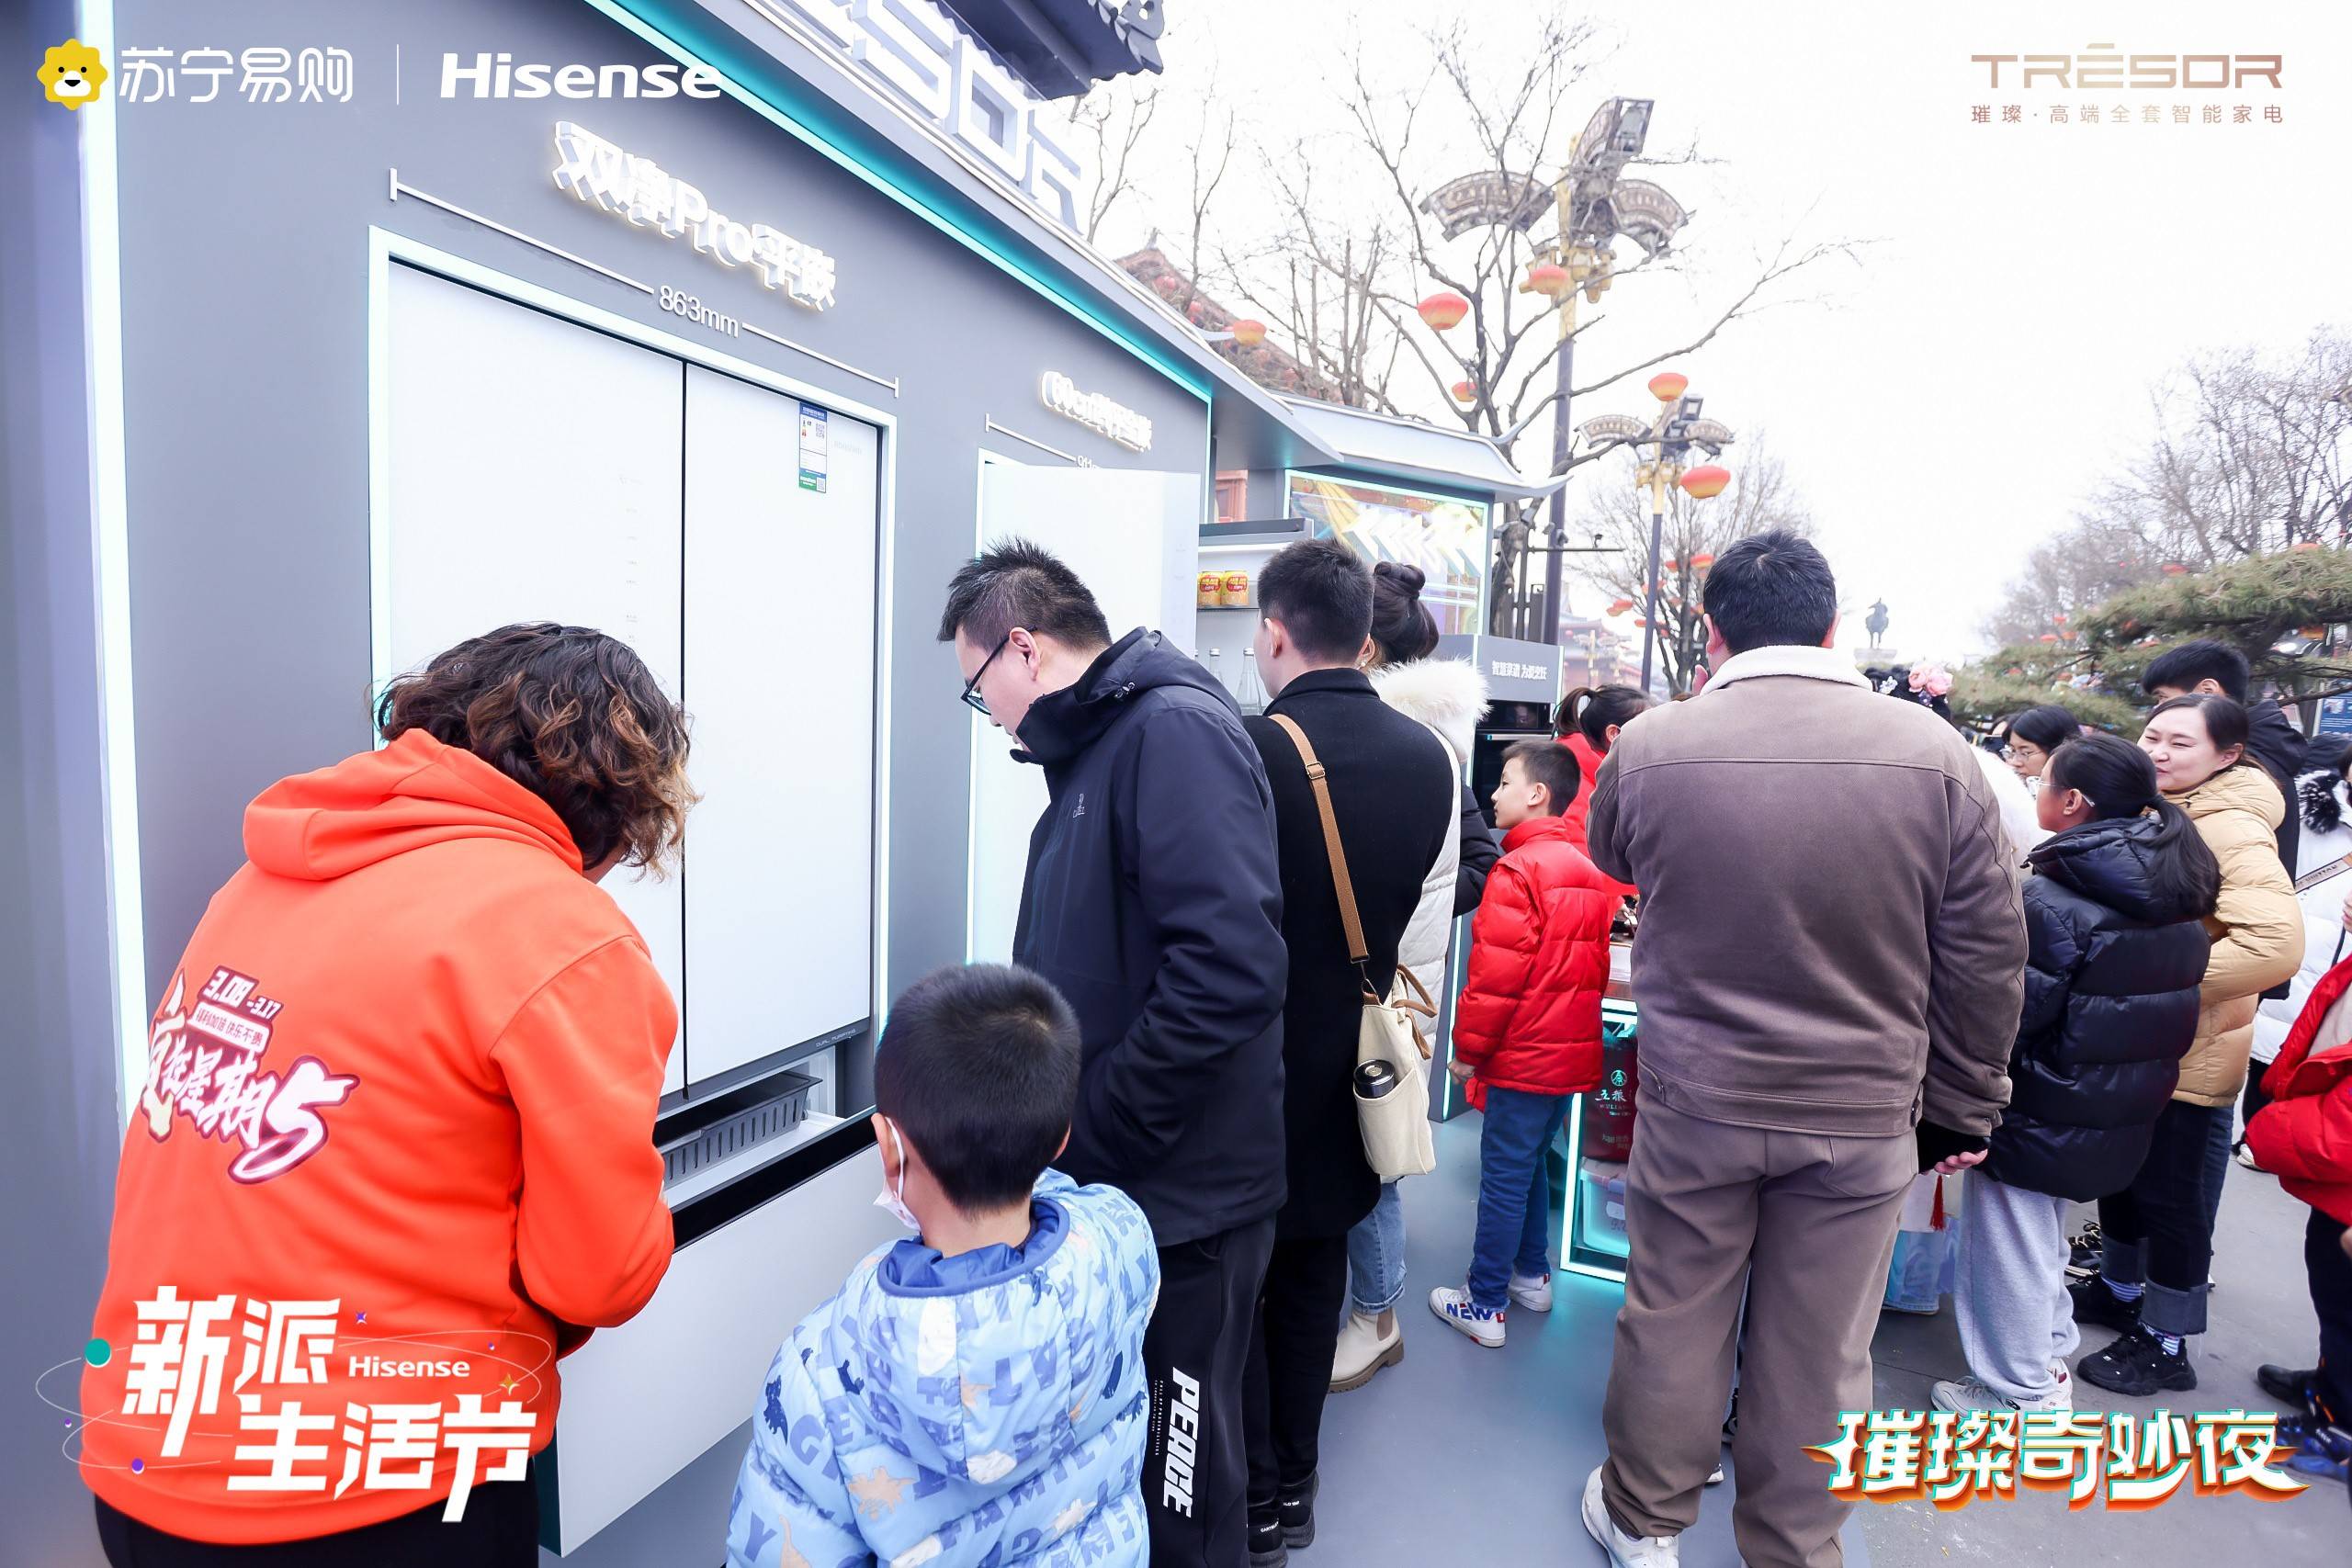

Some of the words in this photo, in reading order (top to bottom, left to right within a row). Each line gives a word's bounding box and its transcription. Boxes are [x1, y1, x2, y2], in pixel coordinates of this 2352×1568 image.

[658, 285, 740, 337] 863mm
[203, 968, 257, 1009] 3.08
[1445, 1302, 1494, 1321] NEW
[1162, 1366, 1200, 1518] PEACE
